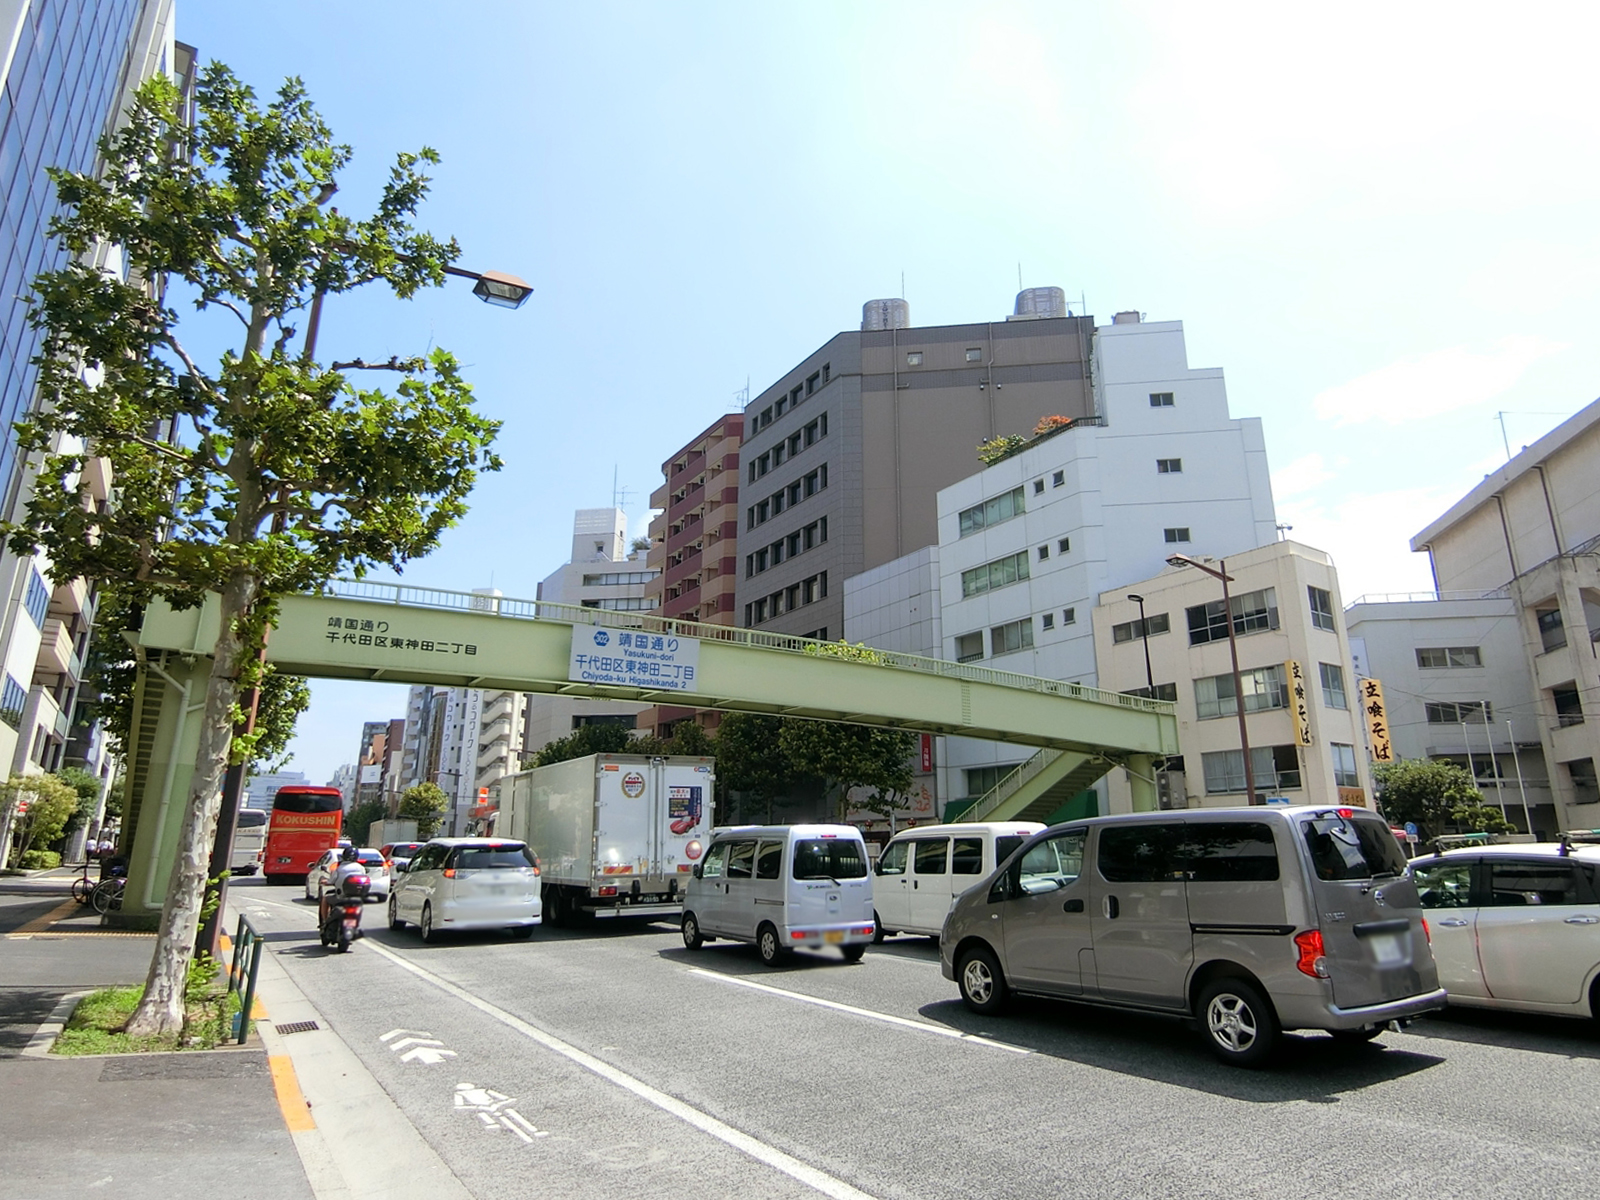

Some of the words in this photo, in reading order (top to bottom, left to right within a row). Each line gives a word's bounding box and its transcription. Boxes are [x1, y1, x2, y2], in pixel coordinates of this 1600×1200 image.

[327, 616, 390, 633] 靖国通り
[325, 631, 477, 655] 千代田区東神田二丁目
[594, 633, 608, 643] 302
[618, 632, 679, 652] 靖国通り
[623, 648, 675, 661] Yasukuni-dori
[575, 654, 694, 680] 千代田区東神田二丁目
[581, 670, 626, 683] Chiyoda-ku
[629, 675, 678, 688] Higashikanda
[681, 681, 687, 689] 2
[1291, 661, 1311, 745] 立喰そば
[1365, 681, 1391, 760] 立喰そば
[275, 814, 336, 825] KOKUSHIN
